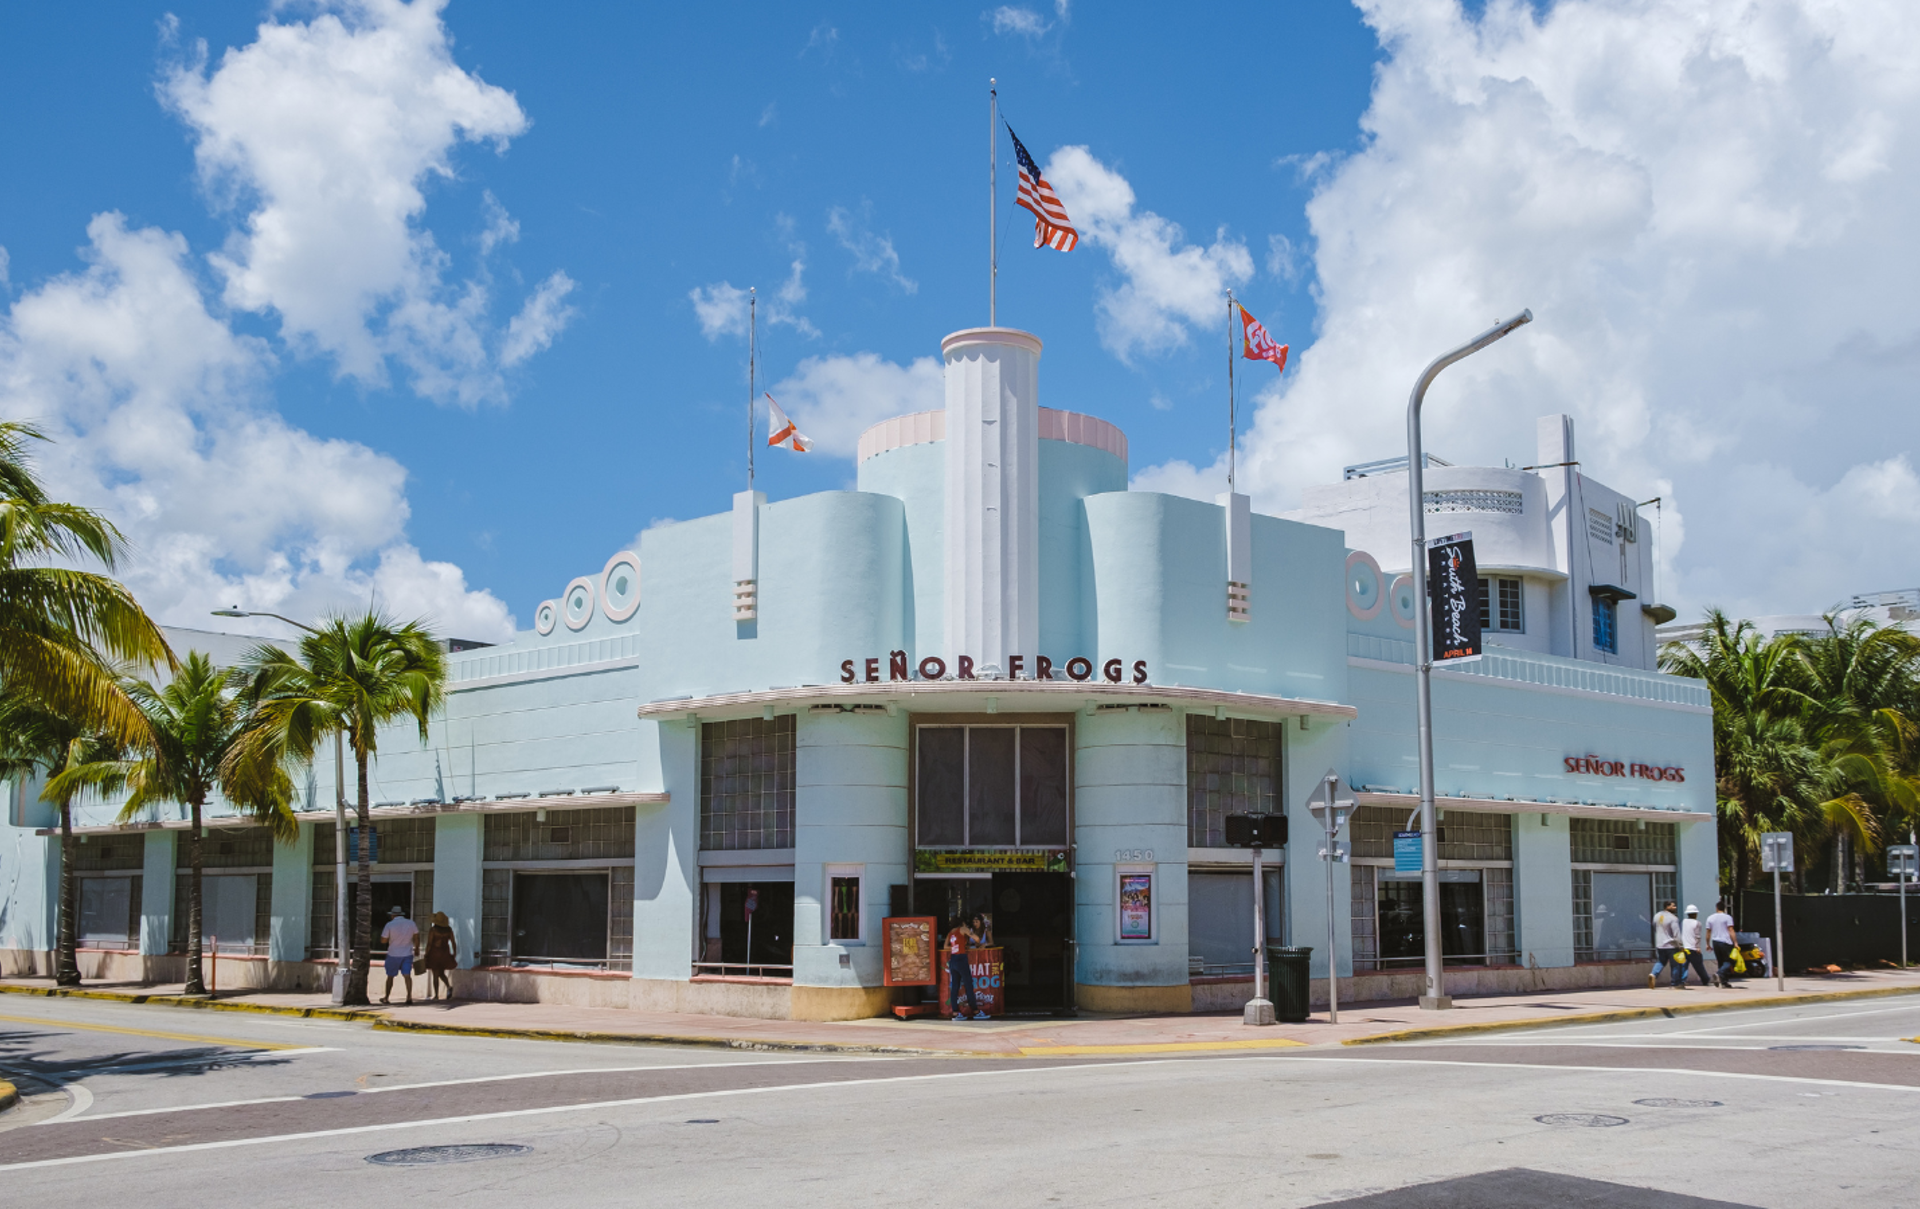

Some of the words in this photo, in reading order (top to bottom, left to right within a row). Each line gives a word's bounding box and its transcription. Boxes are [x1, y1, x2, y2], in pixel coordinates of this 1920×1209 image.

[1446, 546, 1465, 595] South
[1450, 595, 1469, 646] Beach
[1443, 648, 1465, 659] APRIL
[841, 650, 975, 683] SEÑOR
[1009, 655, 1148, 684] FROGS
[1564, 754, 1626, 778] SEÑOR
[1630, 762, 1685, 783] FROGS
[945, 857, 1005, 865] RESTAURANT
[1007, 857, 1014, 865] &
[1016, 857, 1035, 865] BAR
[1115, 849, 1153, 861] 1450
[969, 963, 990, 976] HAT
